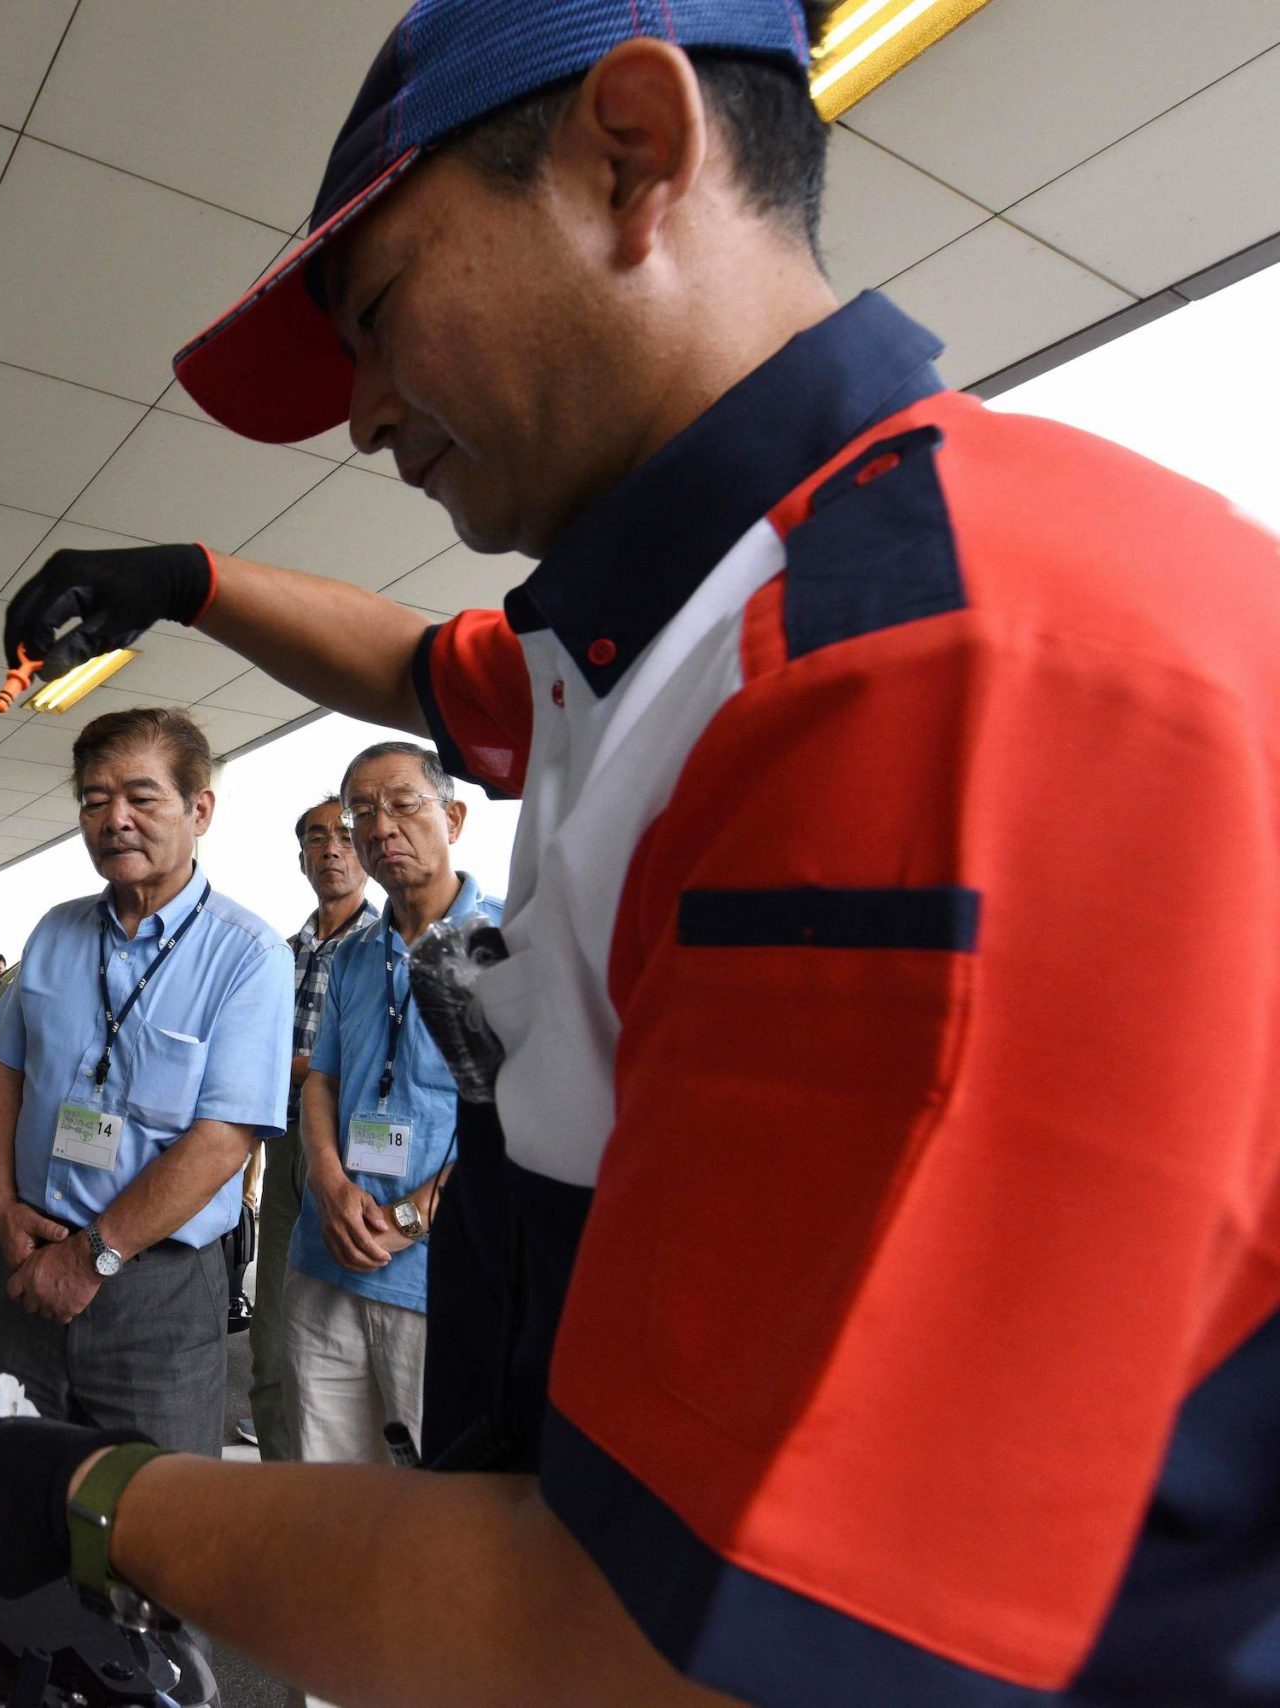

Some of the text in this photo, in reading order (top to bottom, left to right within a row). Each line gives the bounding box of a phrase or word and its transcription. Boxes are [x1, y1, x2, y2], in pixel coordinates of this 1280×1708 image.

[138, 977, 148, 989] JAF
[112, 1021, 120, 1033] JAF
[97, 1121, 112, 1138] 14
[388, 1132, 403, 1147] 18
